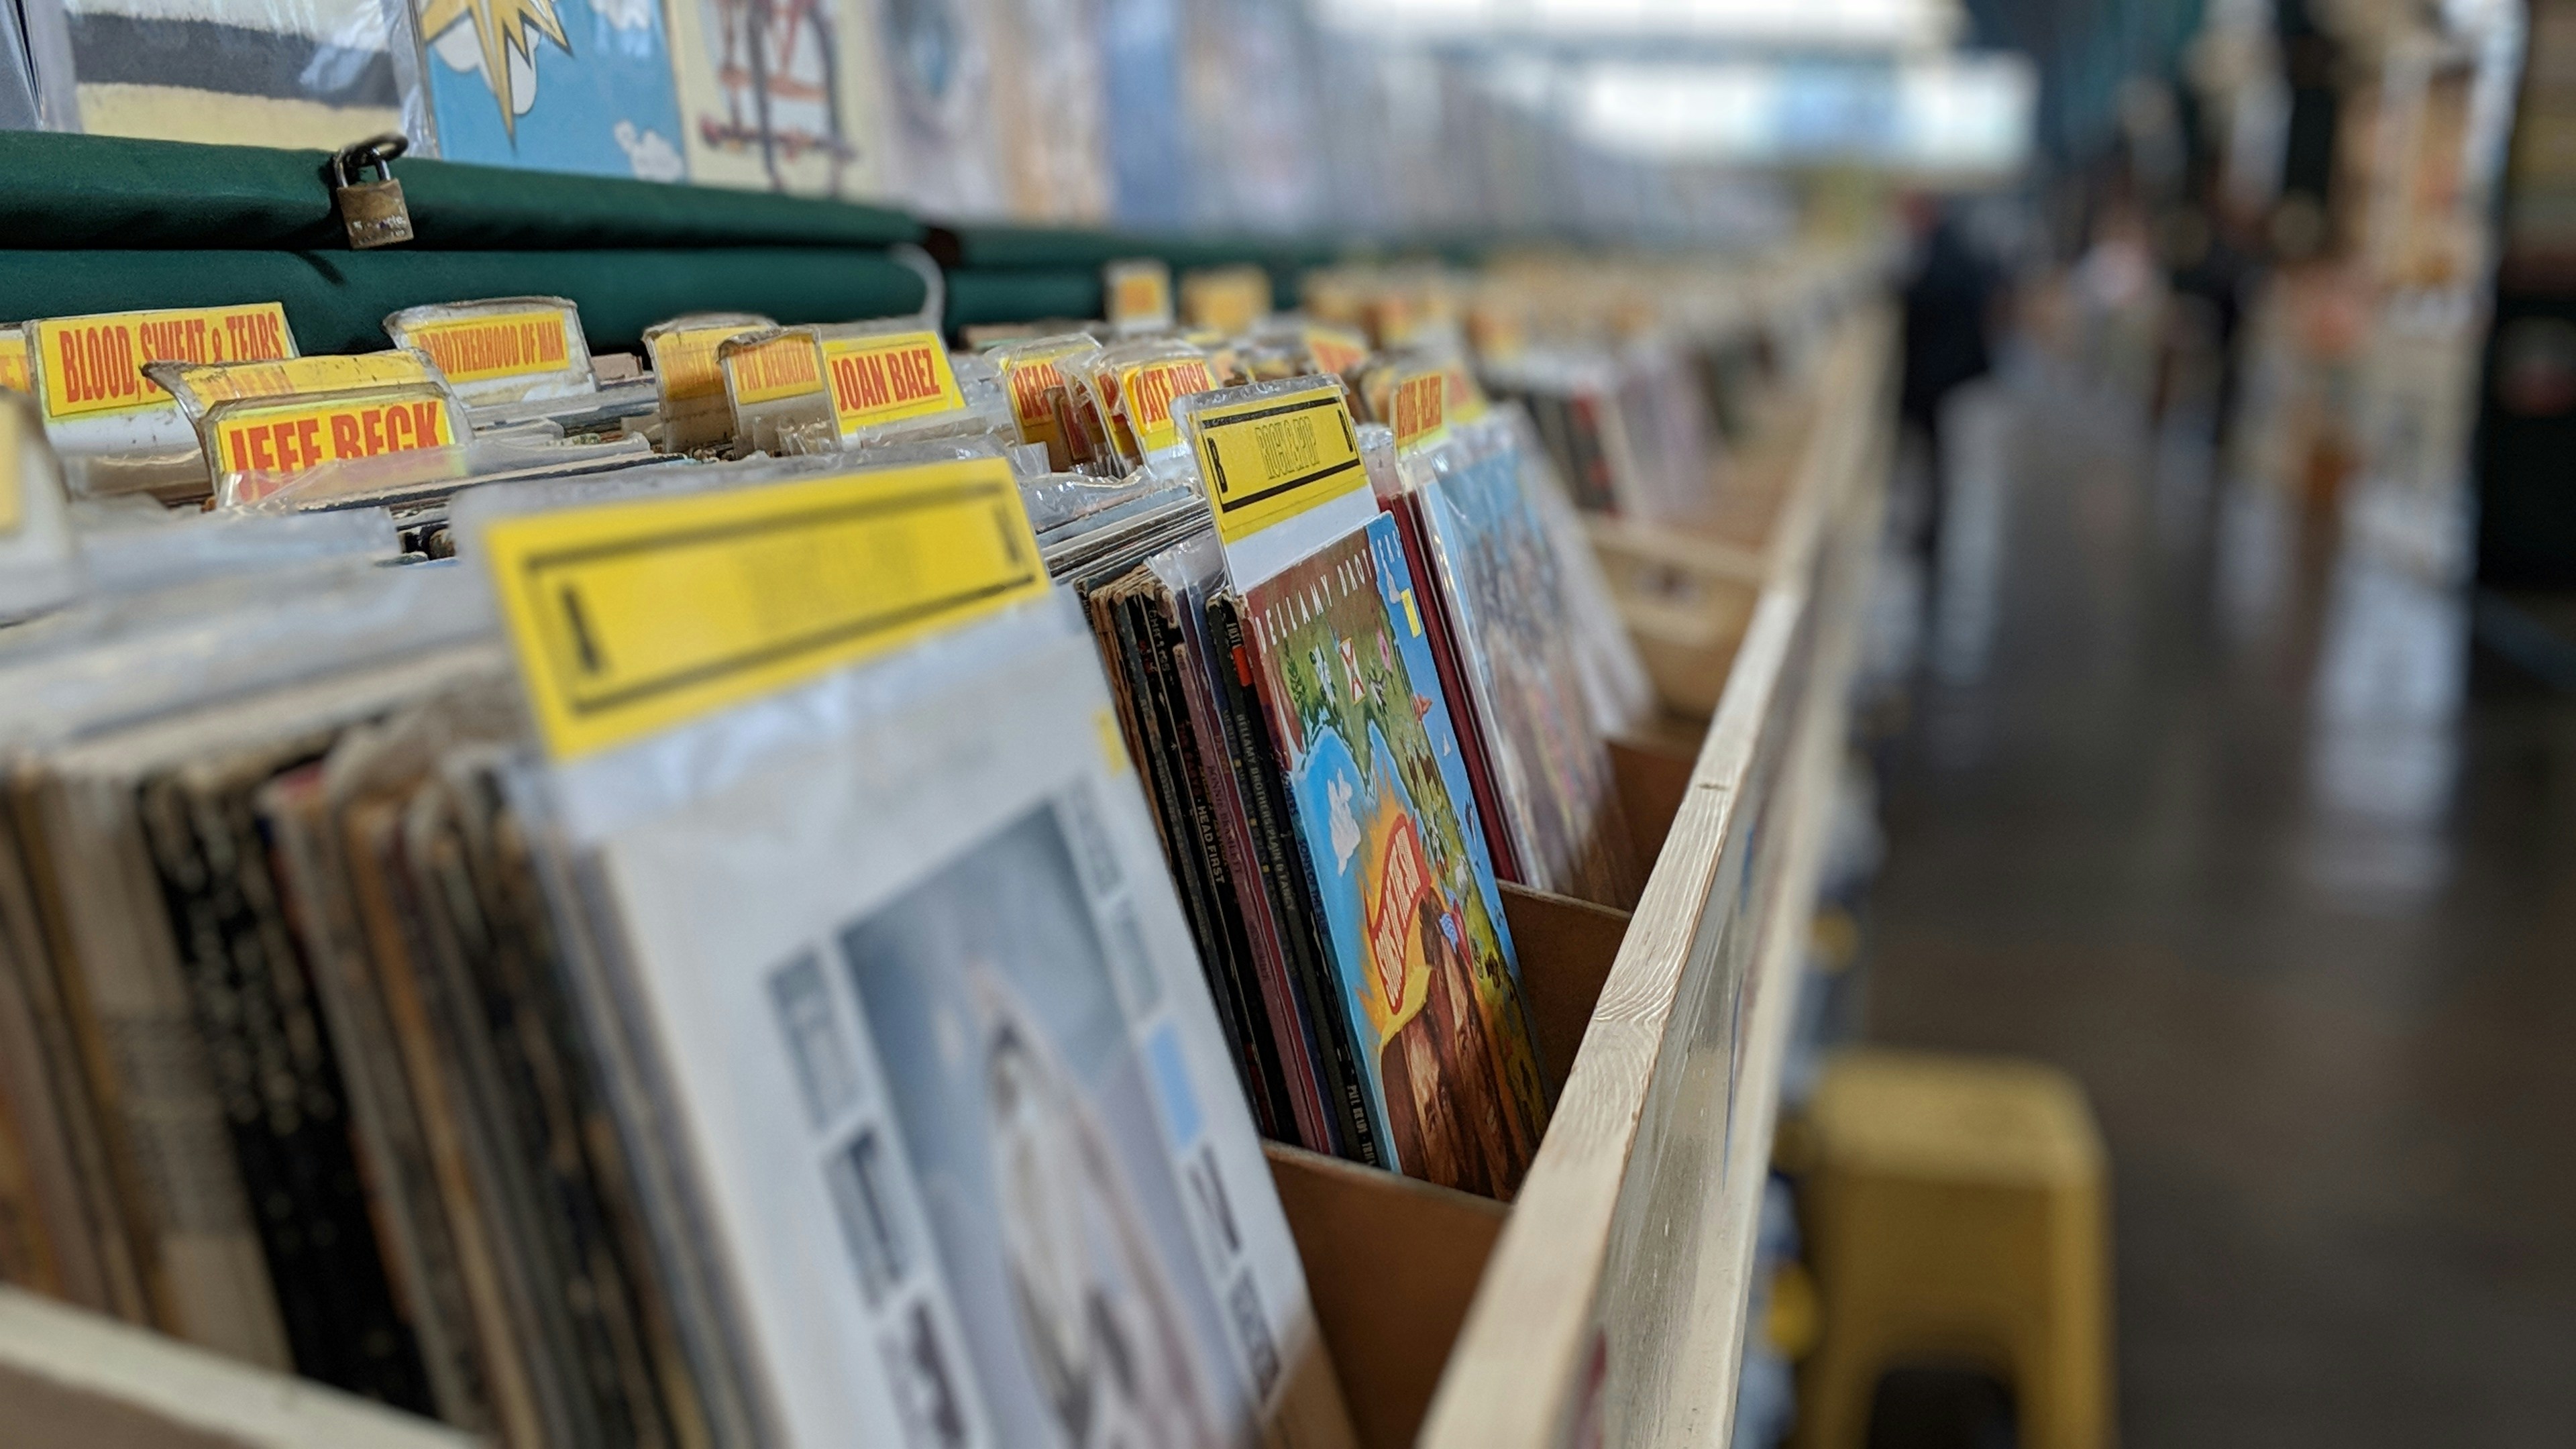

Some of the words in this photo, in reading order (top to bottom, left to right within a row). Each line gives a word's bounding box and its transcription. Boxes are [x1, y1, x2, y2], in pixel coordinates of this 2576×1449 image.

[58, 325, 142, 402] BLOOD,
[140, 318, 207, 394] SWEAT
[211, 327, 223, 362] &
[225, 311, 284, 362] TEARS
[521, 322, 536, 365] OF
[832, 355, 890, 411] JOAN
[885, 347, 941, 401] BAEZ
[229, 417, 323, 500] JEFF
[330, 402, 440, 460] BECK
[1255, 574, 1333, 655] BELLAMY
[1197, 805, 1214, 843] HEAD
[1208, 845, 1226, 884] FIRST
[1208, 765, 1226, 810] BONNIE
[1220, 811, 1241, 871] BRAMLETT
[1236, 714, 1256, 763] BELLAMY
[1277, 875, 1296, 910] FANCY
